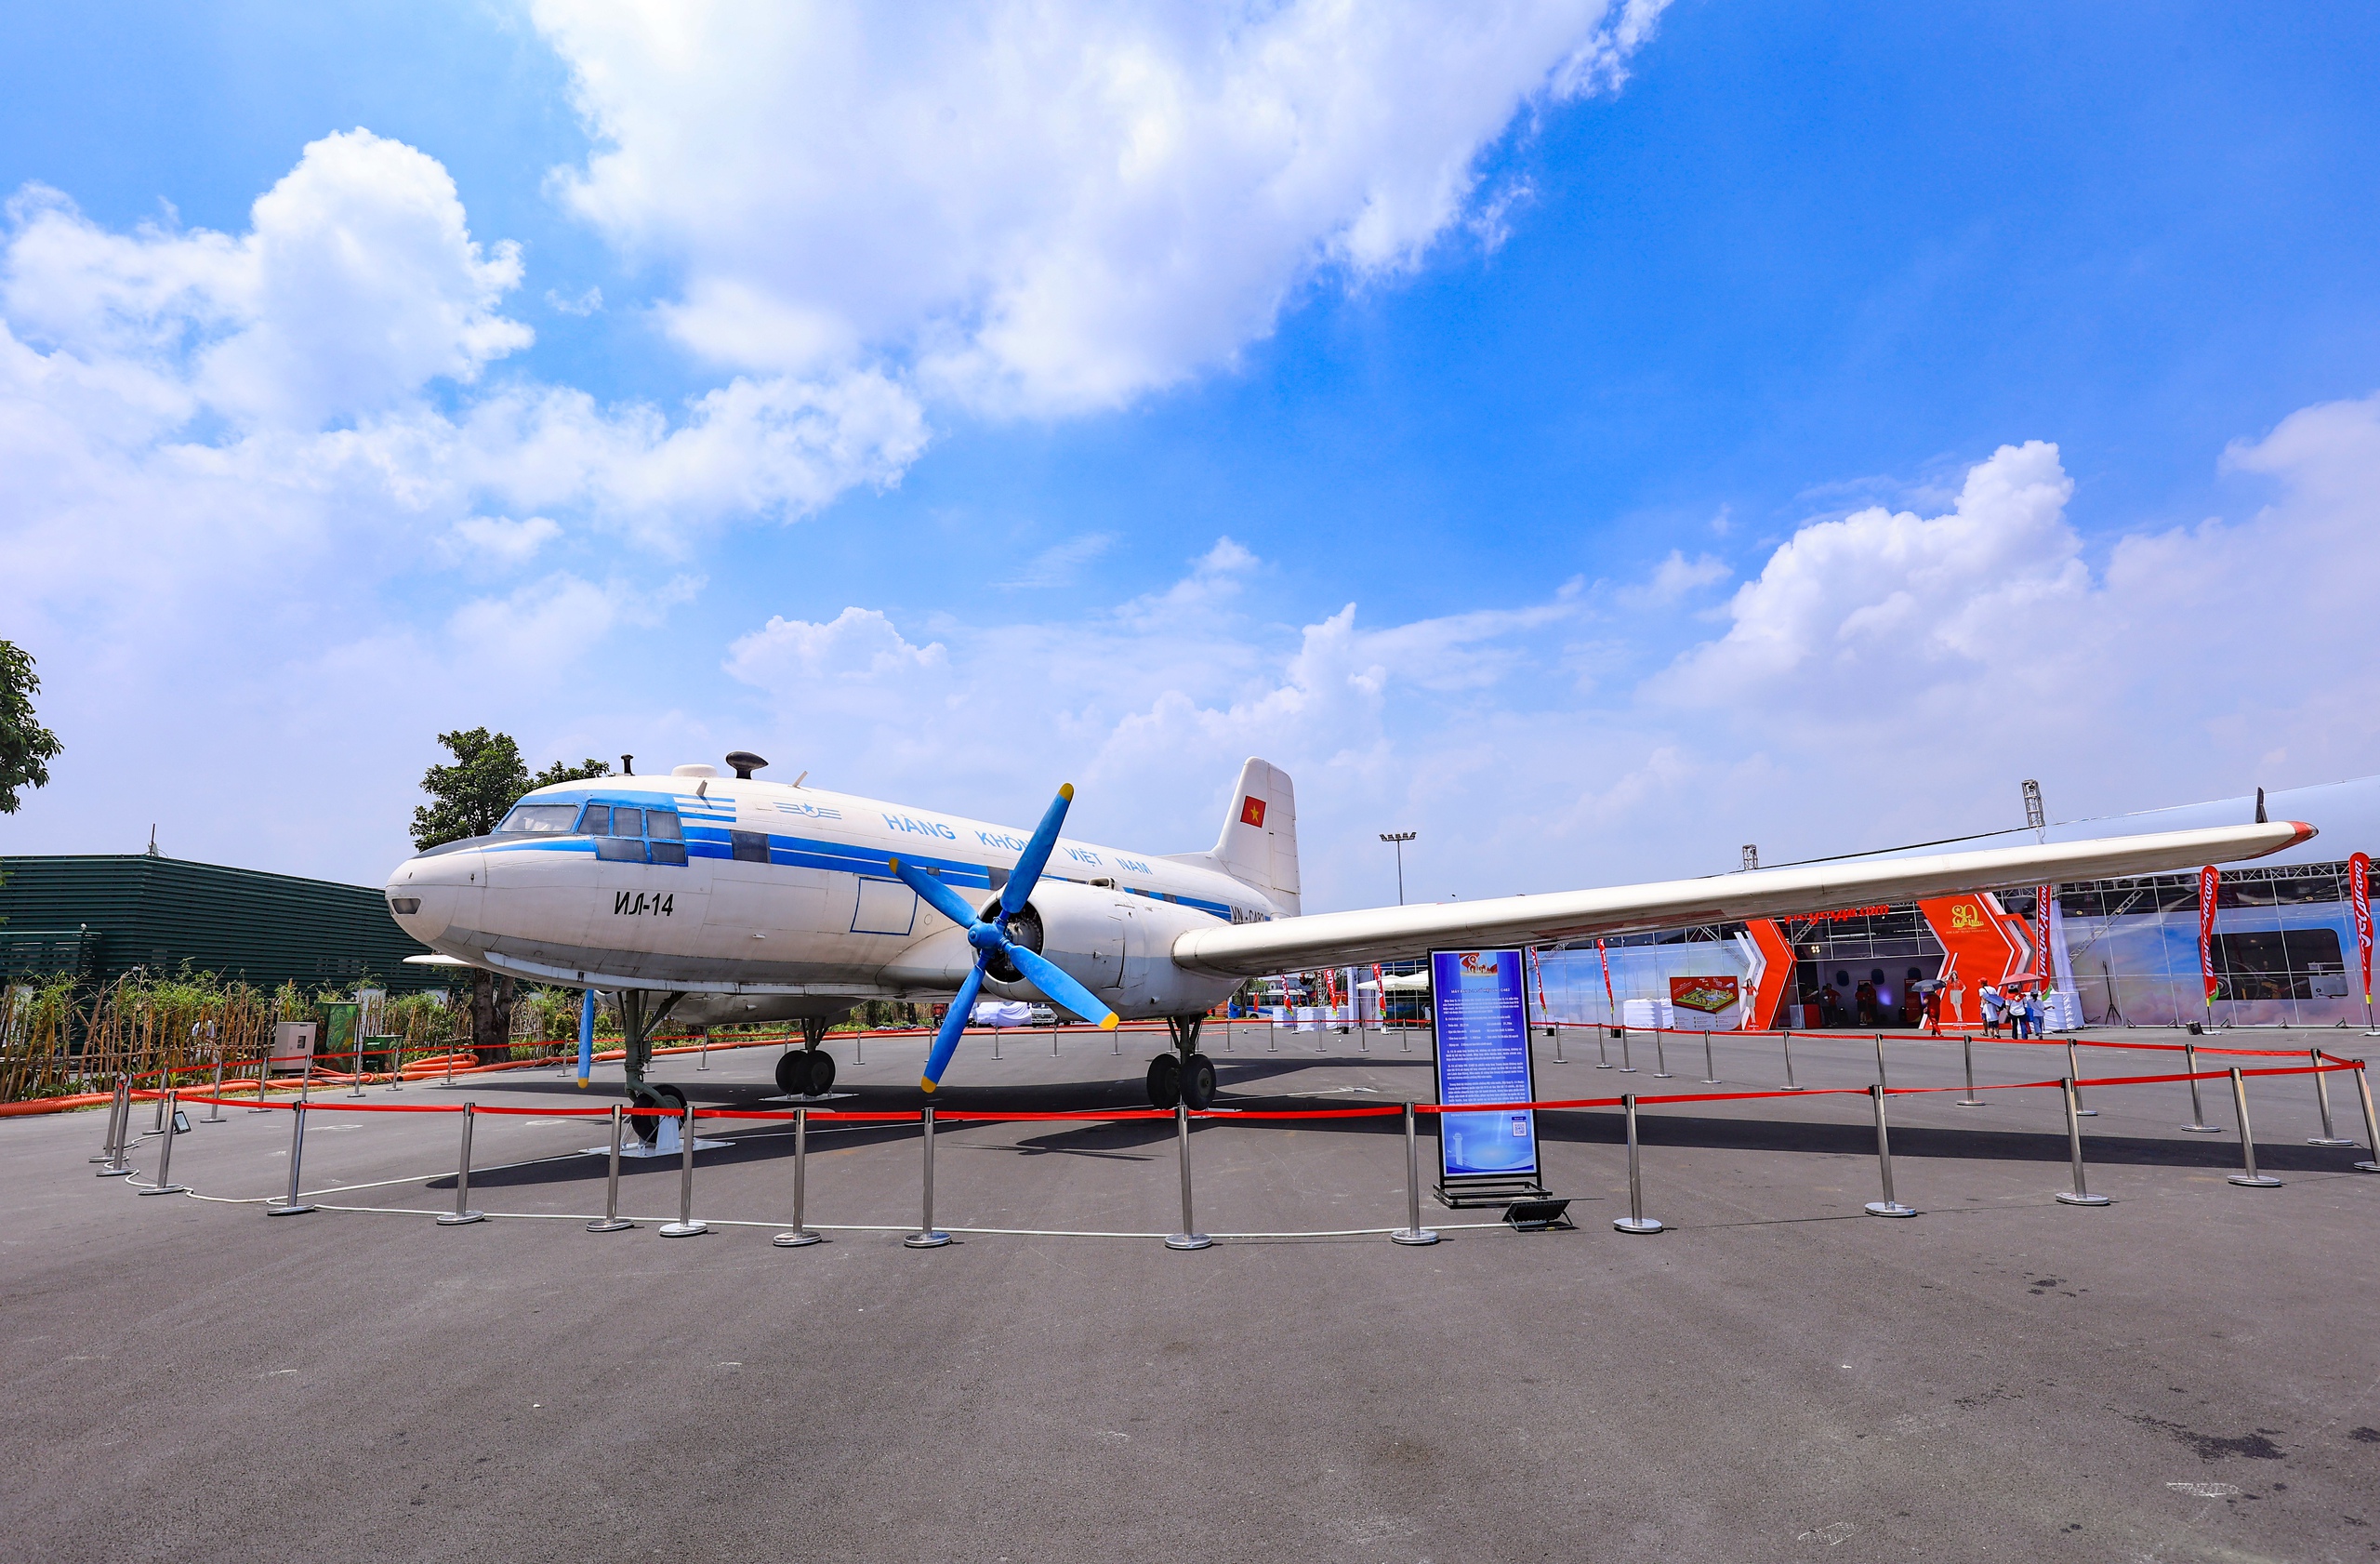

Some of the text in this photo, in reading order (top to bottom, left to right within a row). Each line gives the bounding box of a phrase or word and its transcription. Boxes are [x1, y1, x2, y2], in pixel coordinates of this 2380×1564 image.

[881, 813, 1154, 875] HÀNG KHÔN VIỆT NAM
[614, 891, 674, 917] ИЛ-14
[1231, 905, 1244, 924] VN
